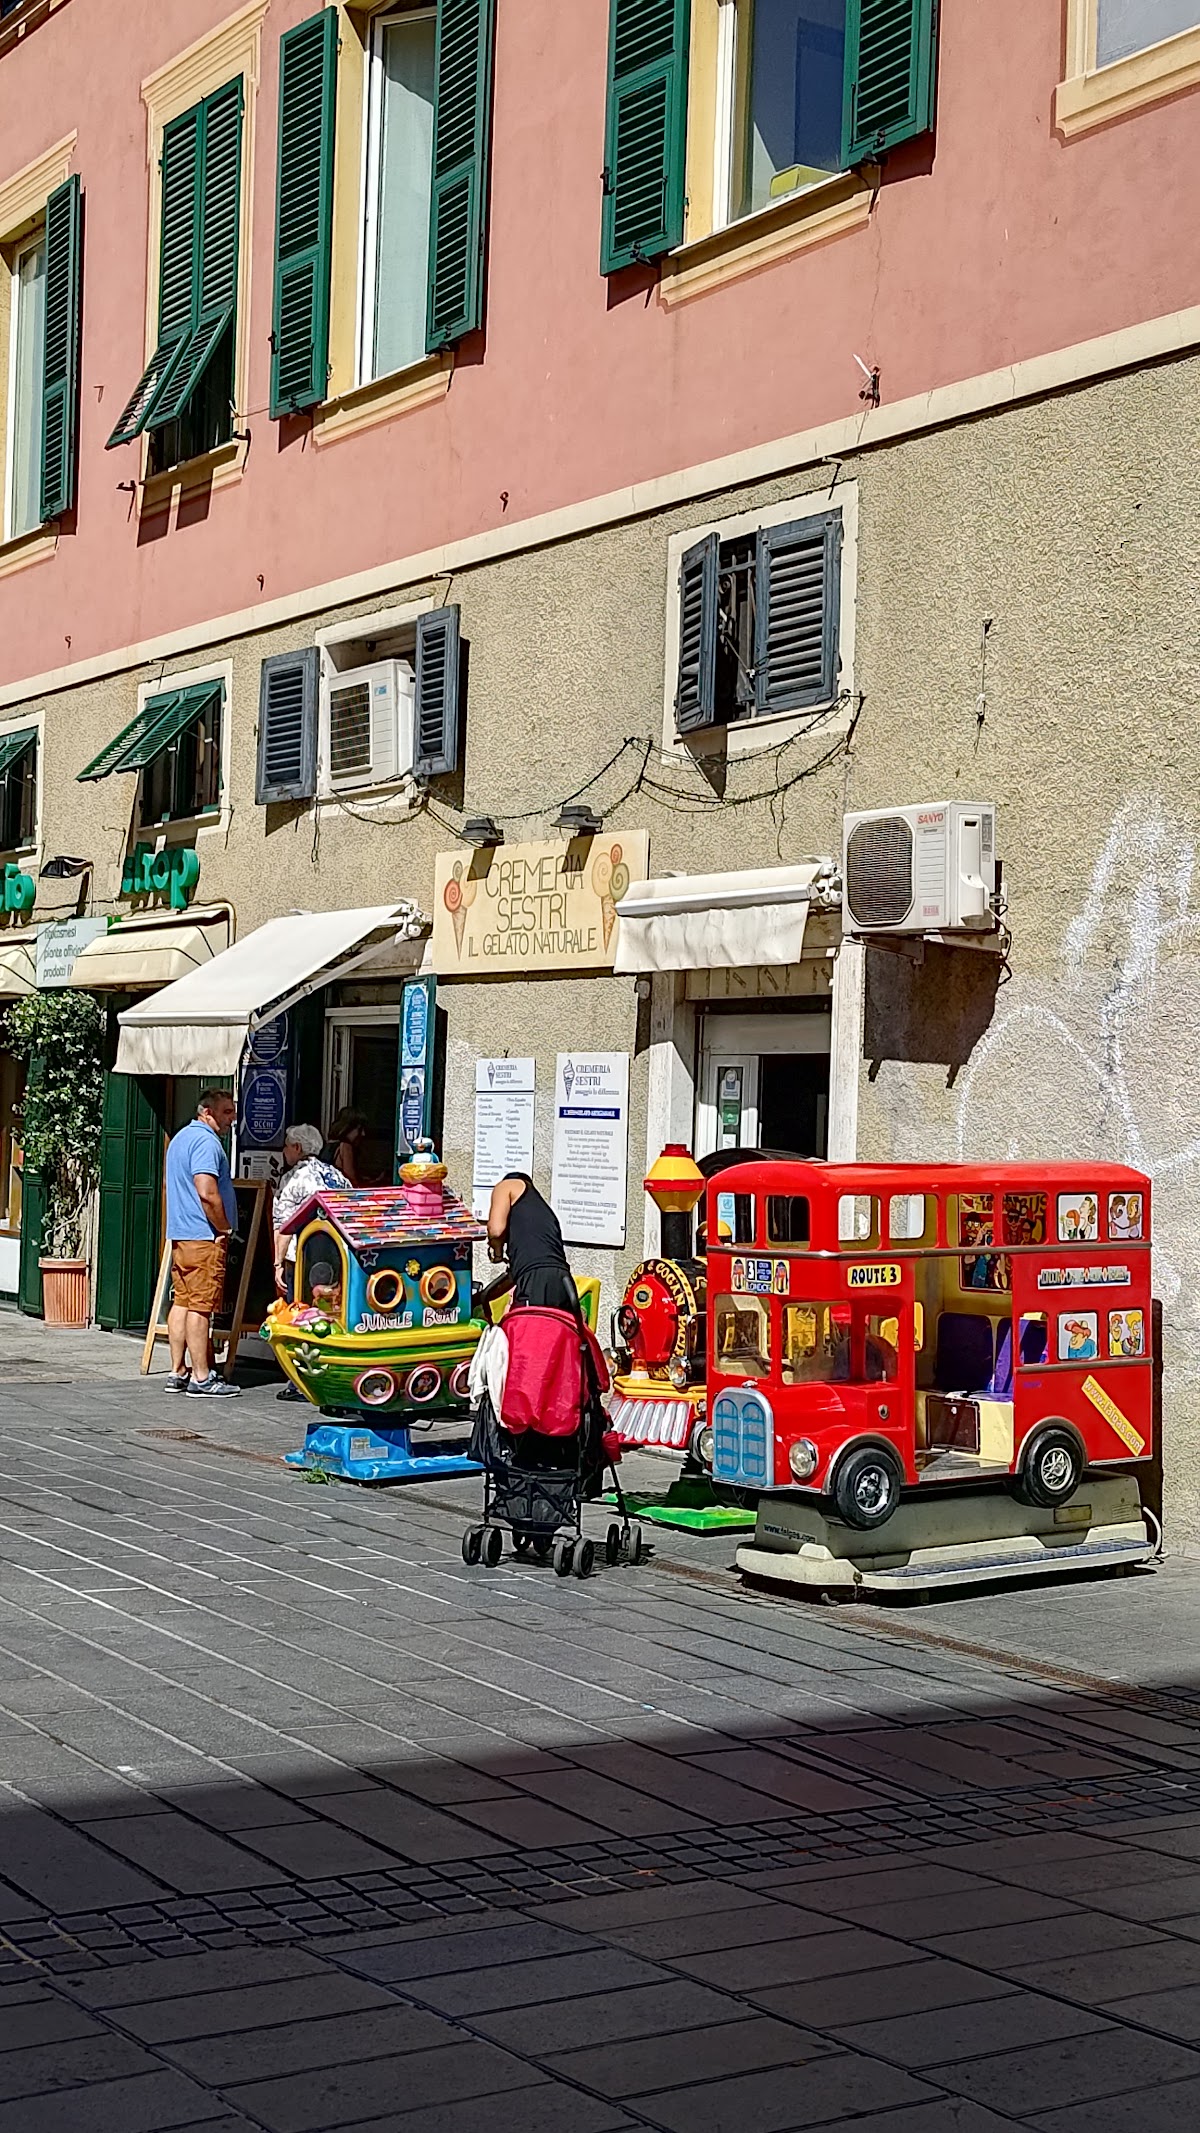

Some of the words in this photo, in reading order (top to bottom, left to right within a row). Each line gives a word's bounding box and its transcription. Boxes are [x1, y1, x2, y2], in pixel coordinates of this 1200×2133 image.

[917, 812, 944, 824] SANYO
[0, 862, 36, 912] io
[485, 854, 584, 898] CREMERIA
[496, 893, 568, 933] SESTRI
[468, 936, 479, 957] IL
[482, 932, 530, 956] GELATO
[533, 927, 598, 955] NATURALE
[575, 1065, 611, 1074] CREMERIA
[575, 1076, 601, 1086] SESTRI
[748, 1261, 755, 1279] 3
[850, 1268, 886, 1285] ROUTE
[889, 1266, 897, 1283] 3
[354, 1311, 413, 1333] JUNGLE
[422, 1306, 461, 1327] BOAT
